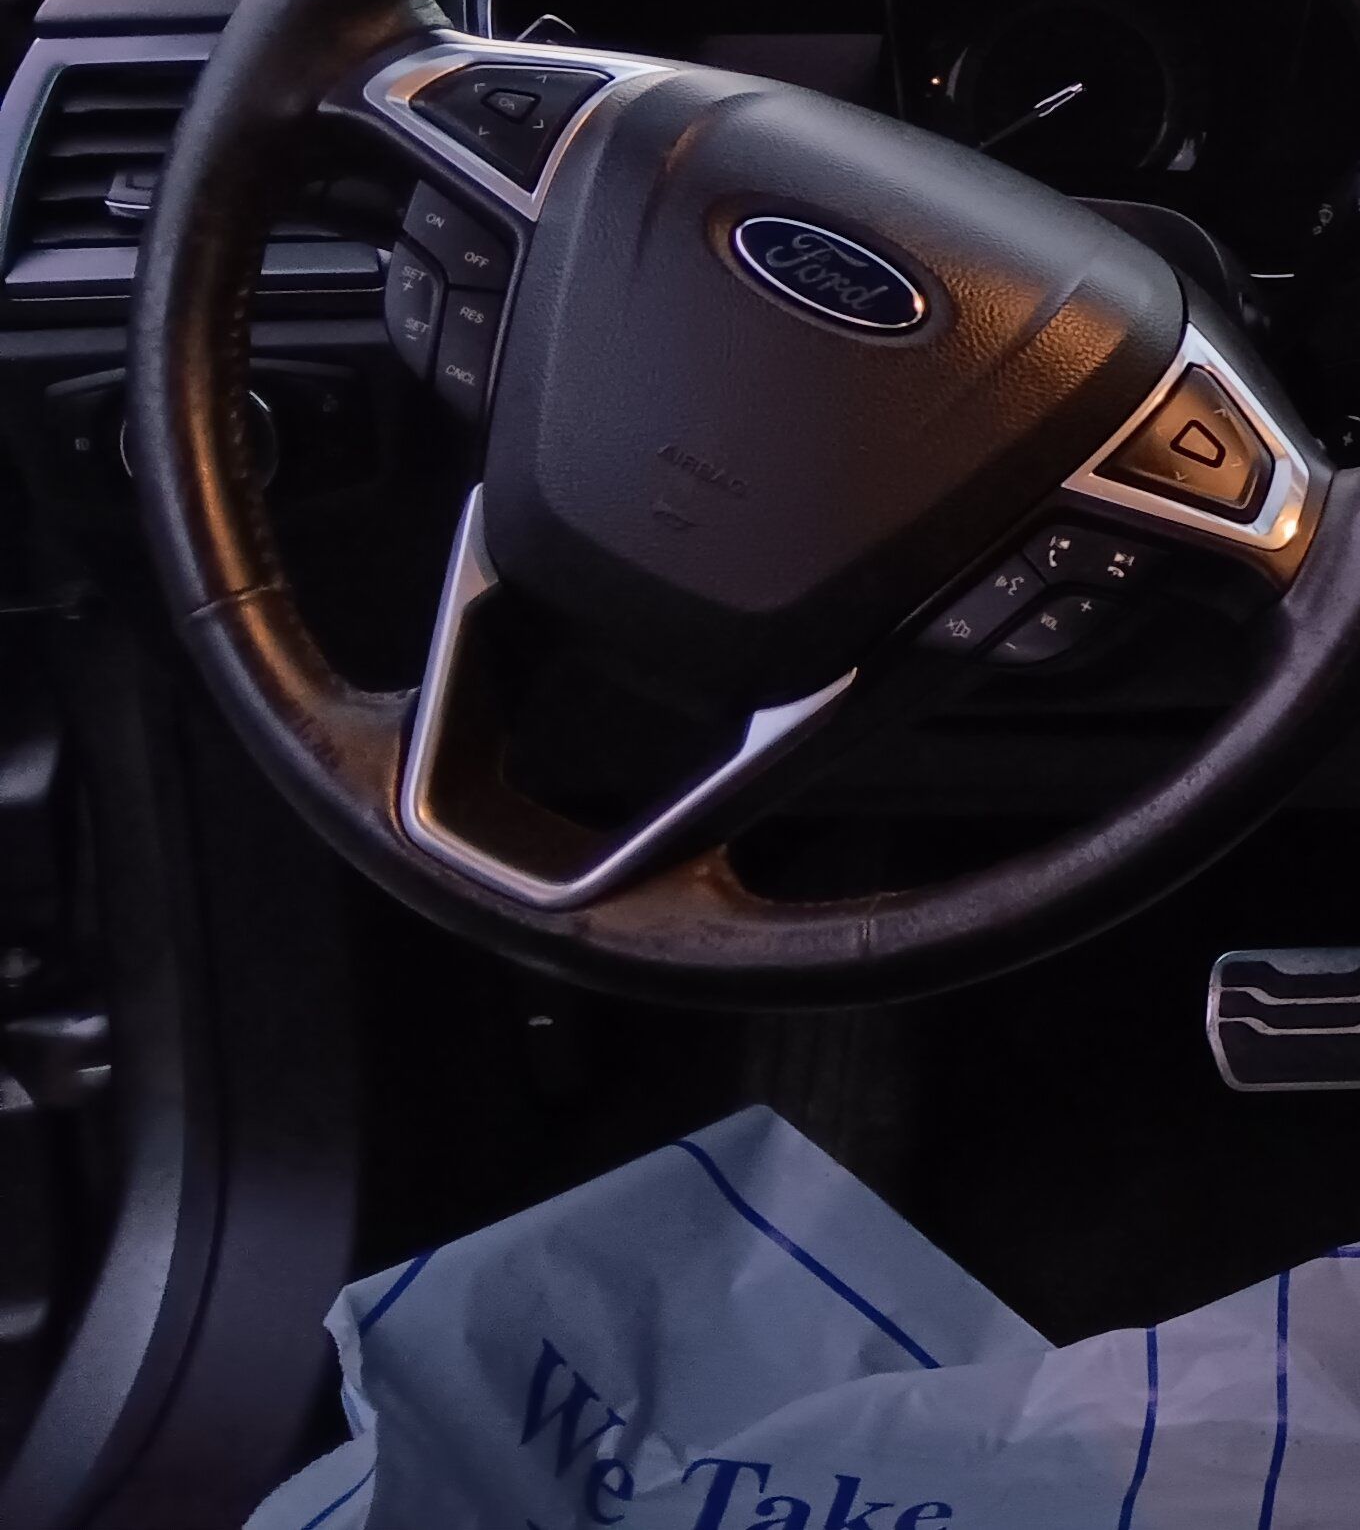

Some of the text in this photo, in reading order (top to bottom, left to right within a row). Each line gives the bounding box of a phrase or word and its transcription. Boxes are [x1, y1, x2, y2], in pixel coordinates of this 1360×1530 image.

[426, 213, 446, 229] ON
[464, 251, 490, 268] OFF
[765, 233, 889, 311] Ford
[460, 306, 484, 325] RES
[445, 364, 476, 386] CNCL
[520, 1337, 634, 1526] We
